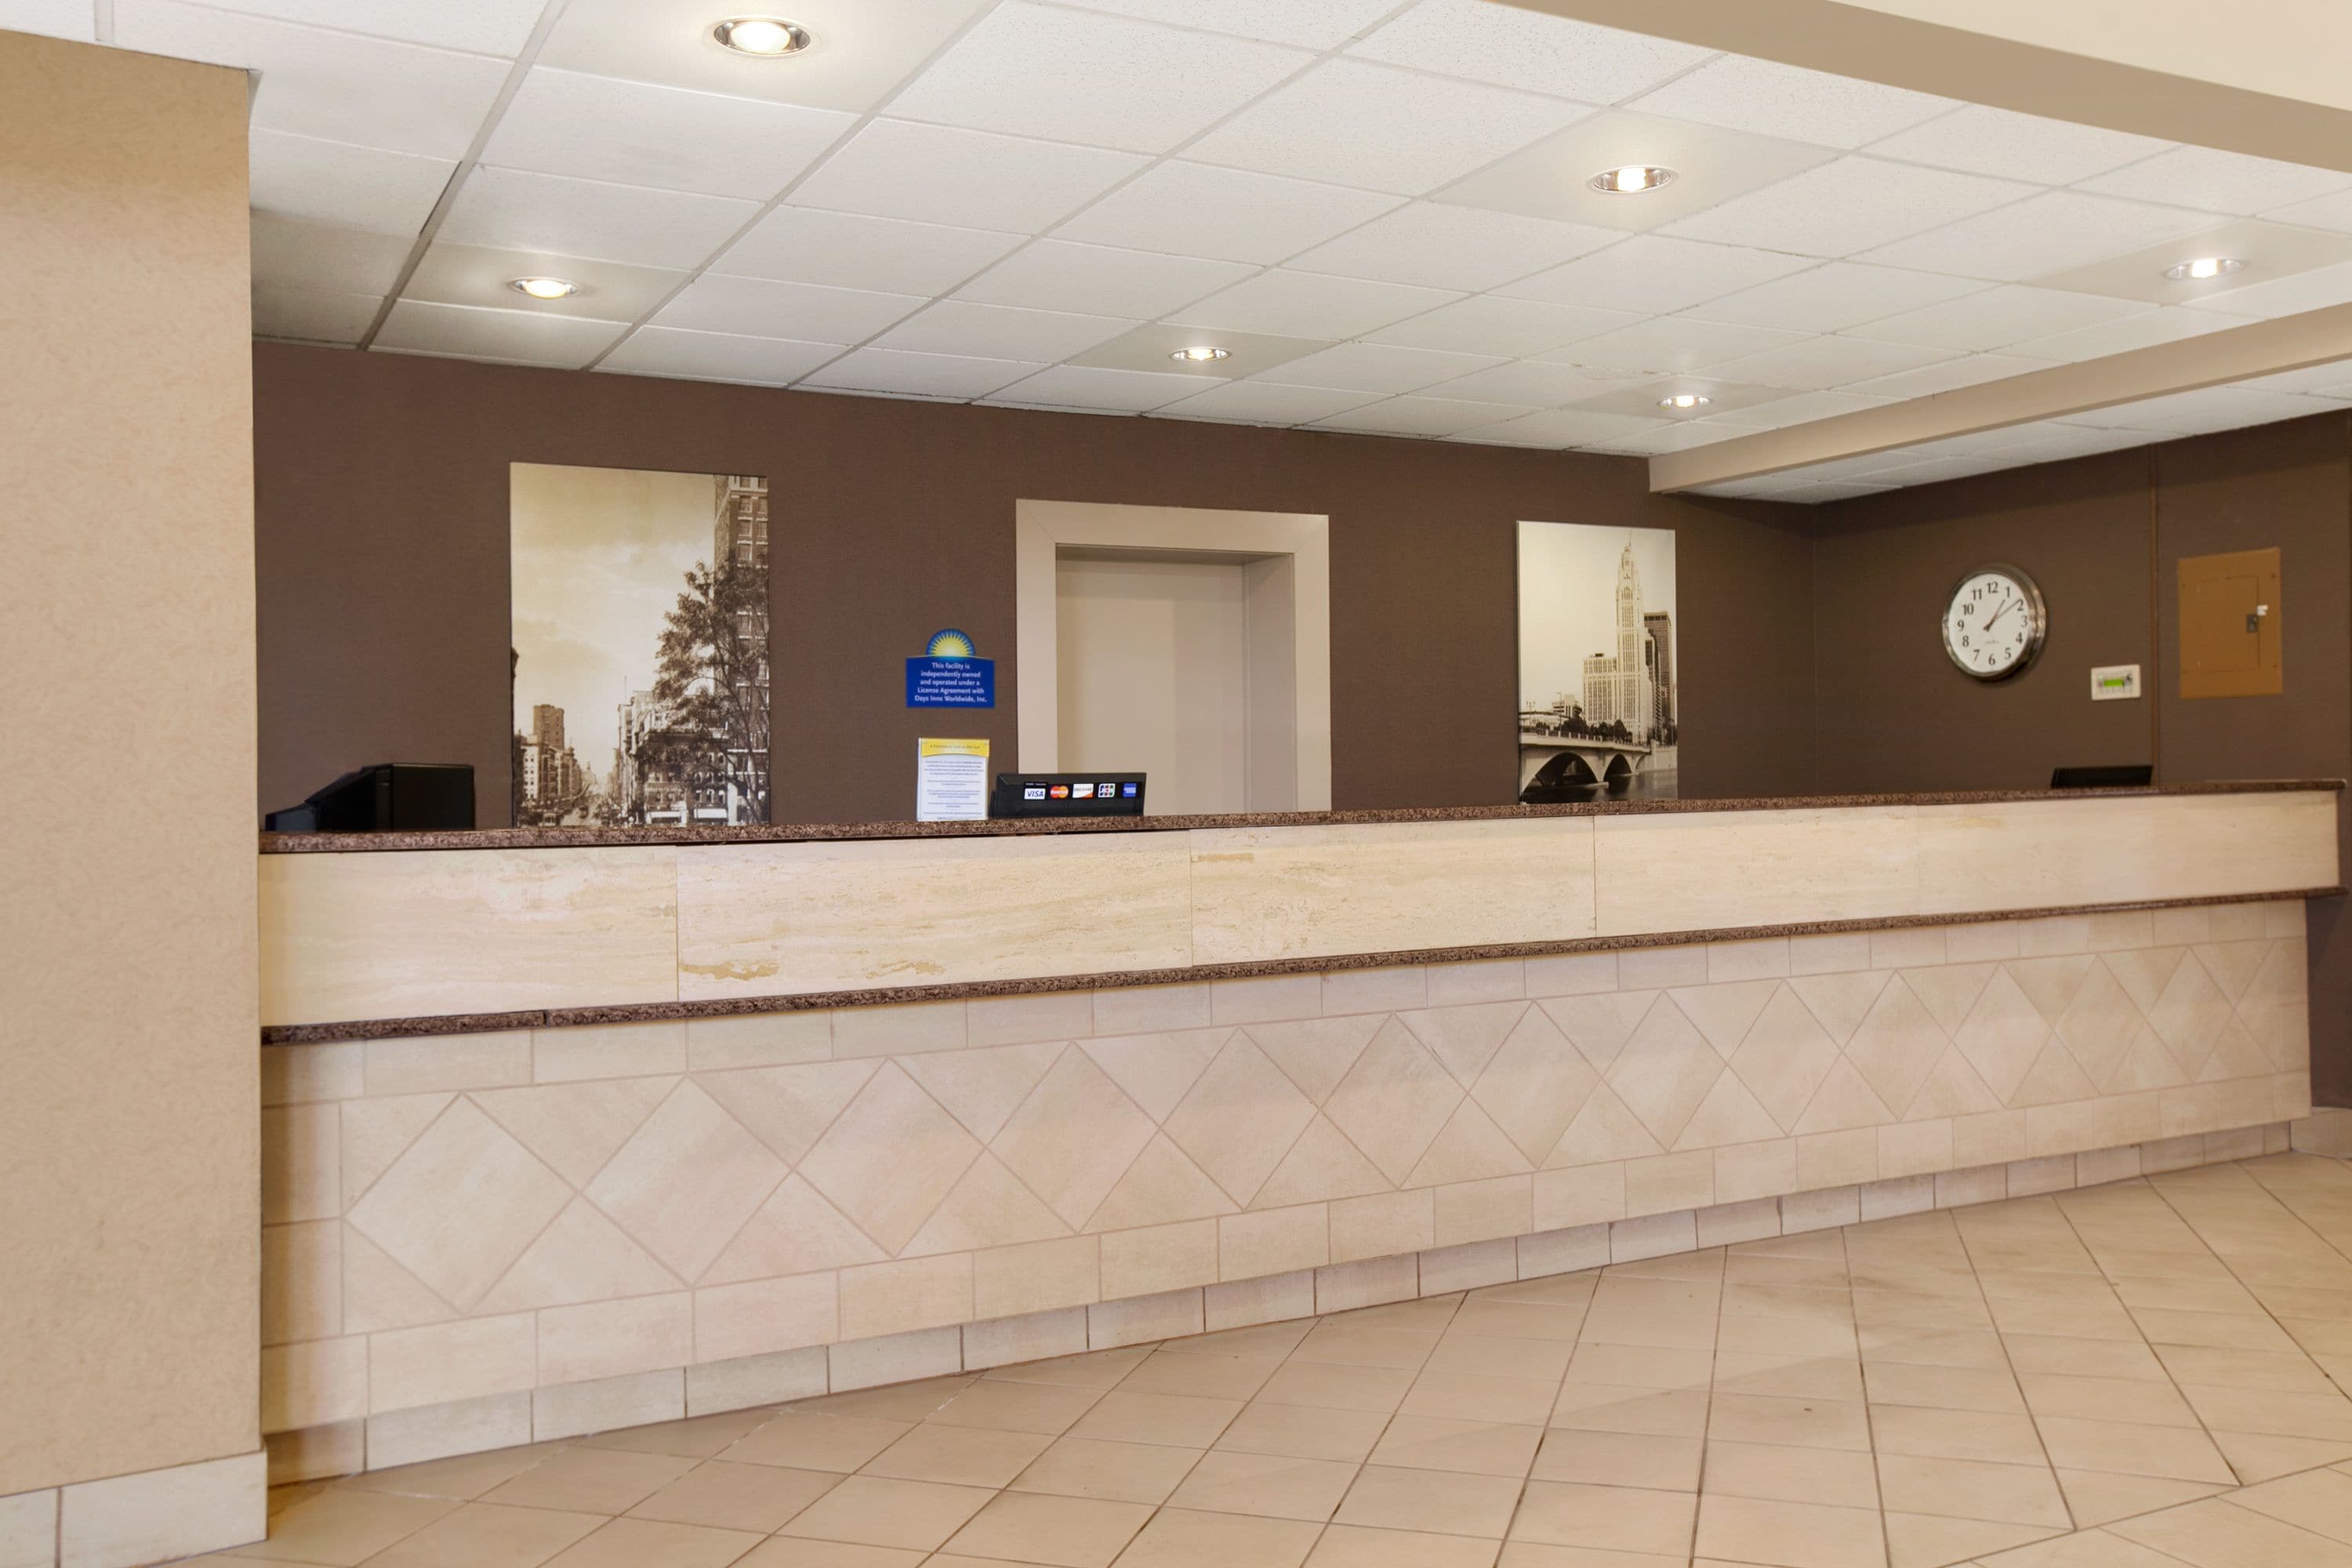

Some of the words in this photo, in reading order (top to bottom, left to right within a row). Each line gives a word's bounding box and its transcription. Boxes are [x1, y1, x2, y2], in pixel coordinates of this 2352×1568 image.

[1987, 581, 1998, 594] 12
[2005, 586, 2010, 598] 1
[1972, 589, 1982, 601] 11
[1962, 604, 1974, 615] 10
[2017, 599, 2024, 611] 2
[1958, 620, 1965, 631] 9
[2020, 615, 2028, 627] 3
[1962, 635, 1969, 647] 8
[2016, 632, 2024, 644] 4
[1973, 649, 1980, 662] 7
[1988, 653, 1995, 666] 6
[2004, 648, 2011, 659] 5
